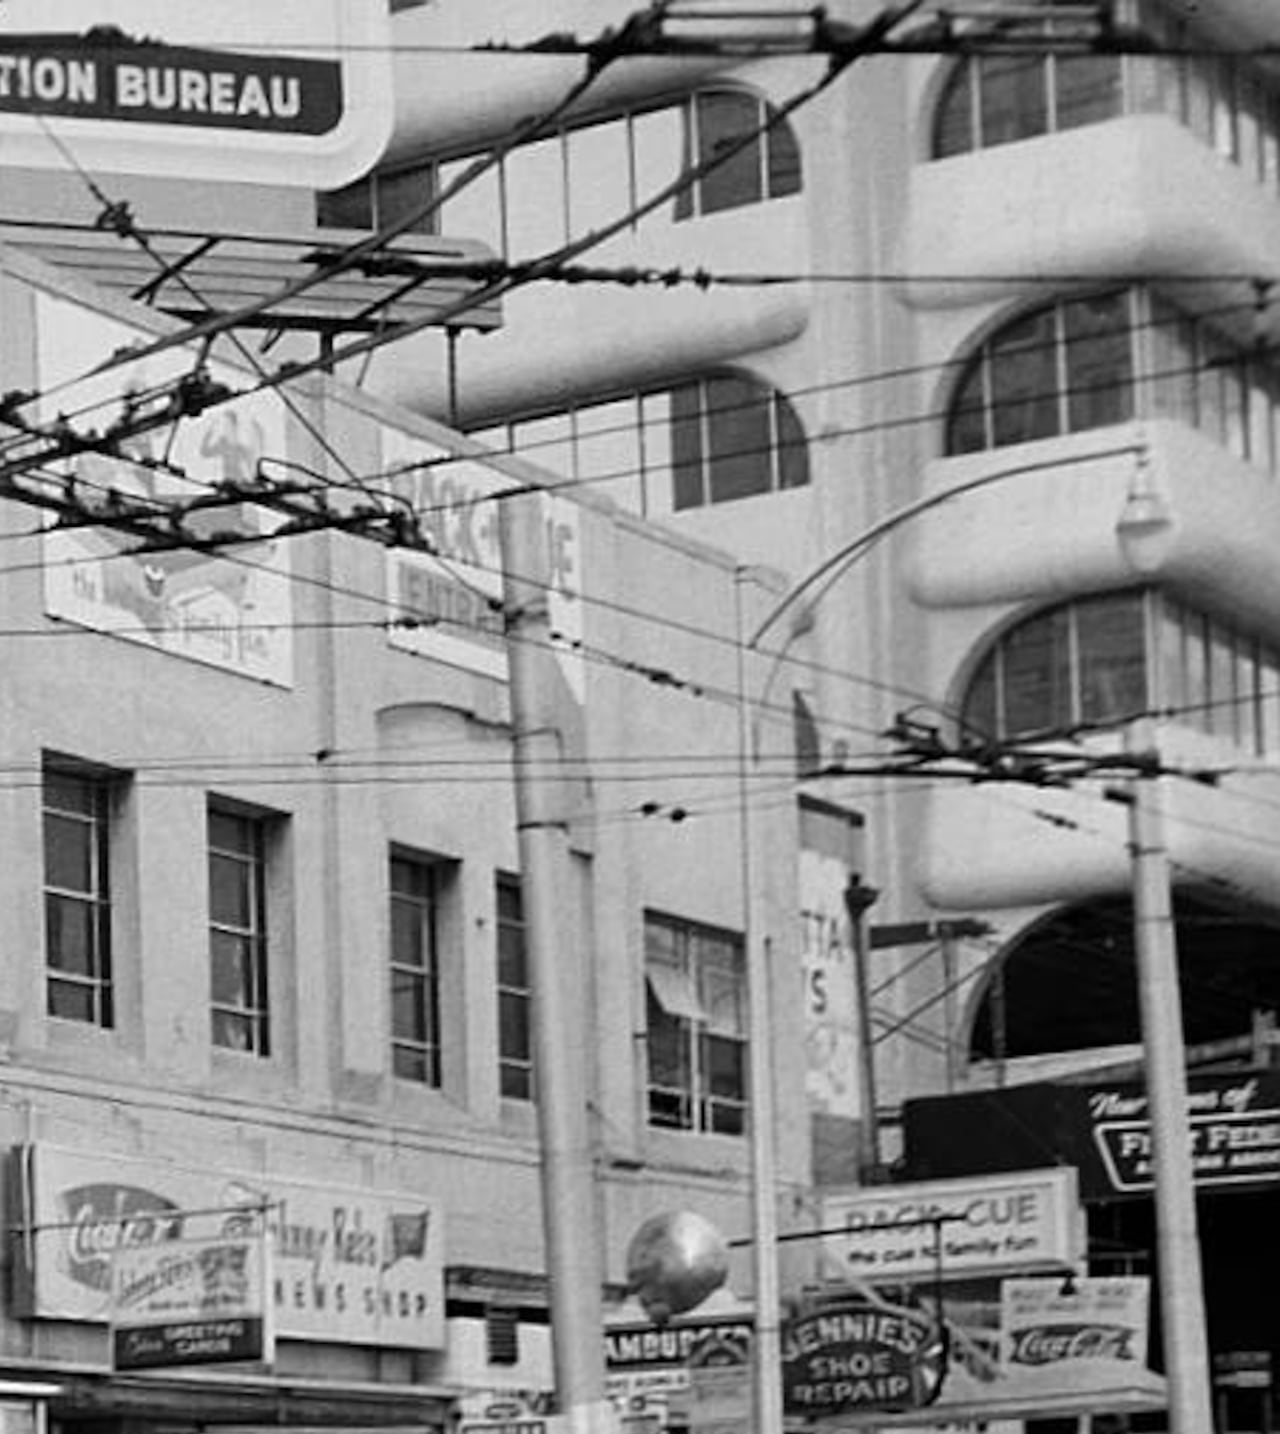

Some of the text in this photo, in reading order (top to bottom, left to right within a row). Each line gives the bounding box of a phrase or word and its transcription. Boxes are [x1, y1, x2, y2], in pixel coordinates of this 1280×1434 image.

[116, 64, 300, 118] BUREAU
[966, 1193, 1038, 1229] CUE
[273, 1279, 426, 1319] NEWS SHOP
[808, 1352, 892, 1380] SHOE
[793, 1374, 910, 1404] REPAIR
